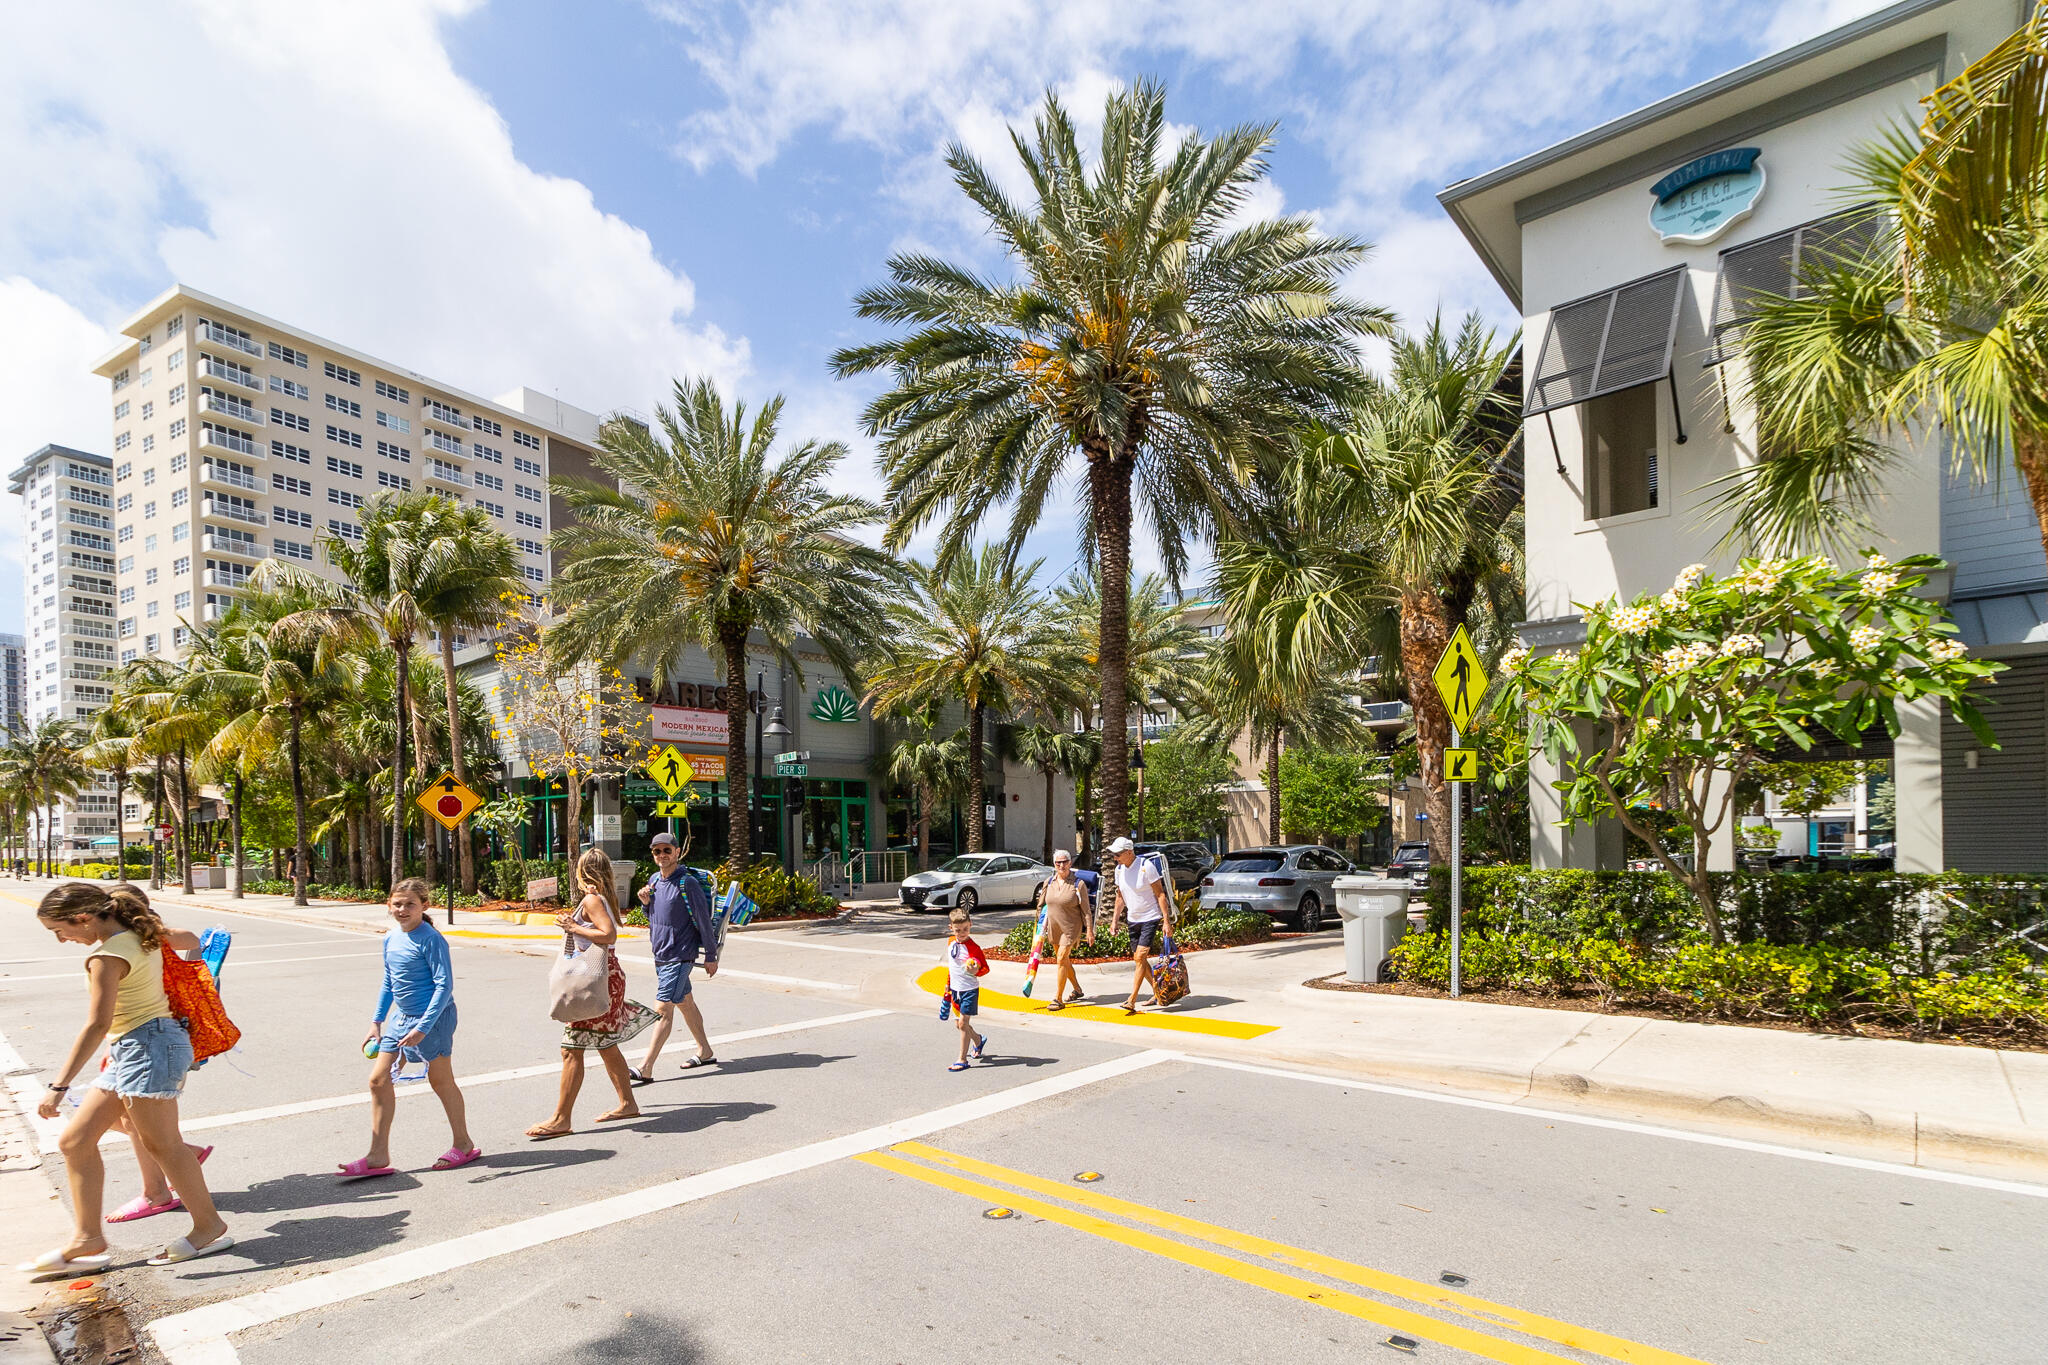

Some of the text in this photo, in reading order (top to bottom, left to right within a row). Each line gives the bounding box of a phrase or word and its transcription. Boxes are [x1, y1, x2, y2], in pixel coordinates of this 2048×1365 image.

[1663, 150, 1743, 191] POMPANO
[1680, 181, 1730, 209] BEACH
[636, 677, 767, 714] BARESO
[661, 721, 729, 733] MODERN MEXICAN
[778, 765, 806, 775] PIER ST
